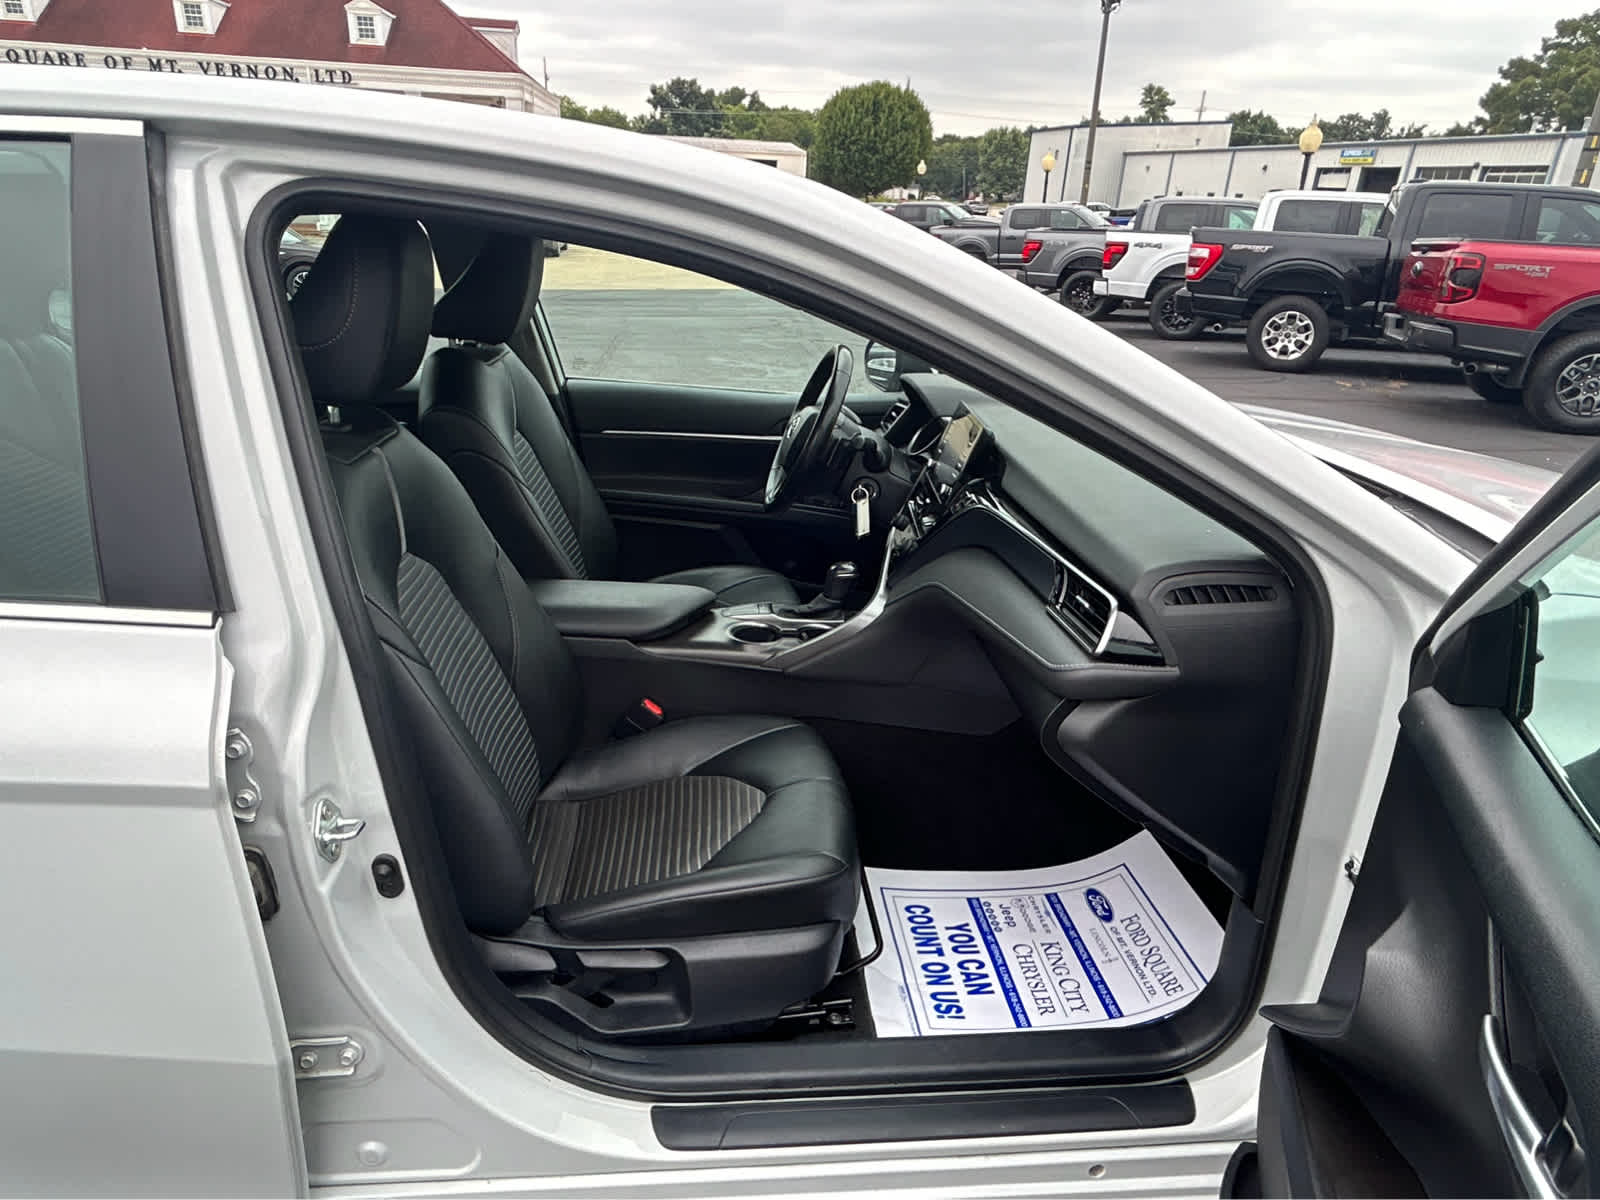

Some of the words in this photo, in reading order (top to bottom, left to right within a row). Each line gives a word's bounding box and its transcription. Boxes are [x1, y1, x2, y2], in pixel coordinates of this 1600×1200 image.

[104, 55, 133, 71] OF
[147, 58, 184, 73] MT.
[1494, 263, 1556, 273] SPORT
[999, 904, 1016, 927] Jeep
[1088, 893, 1110, 917] Ford
[904, 904, 945, 957] COUNT
[944, 922, 981, 954] YOU
[1120, 913, 1151, 947] FORD
[1140, 945, 1184, 996] SQUARE
[1125, 949, 1147, 980] VERNON
[921, 962, 955, 986] ON
[956, 959, 995, 995] CAN
[1012, 943, 1056, 1016] CHRYSLER
[1040, 941, 1071, 976] KING
[1058, 978, 1090, 1013] CITY
[929, 991, 966, 1020] US!
